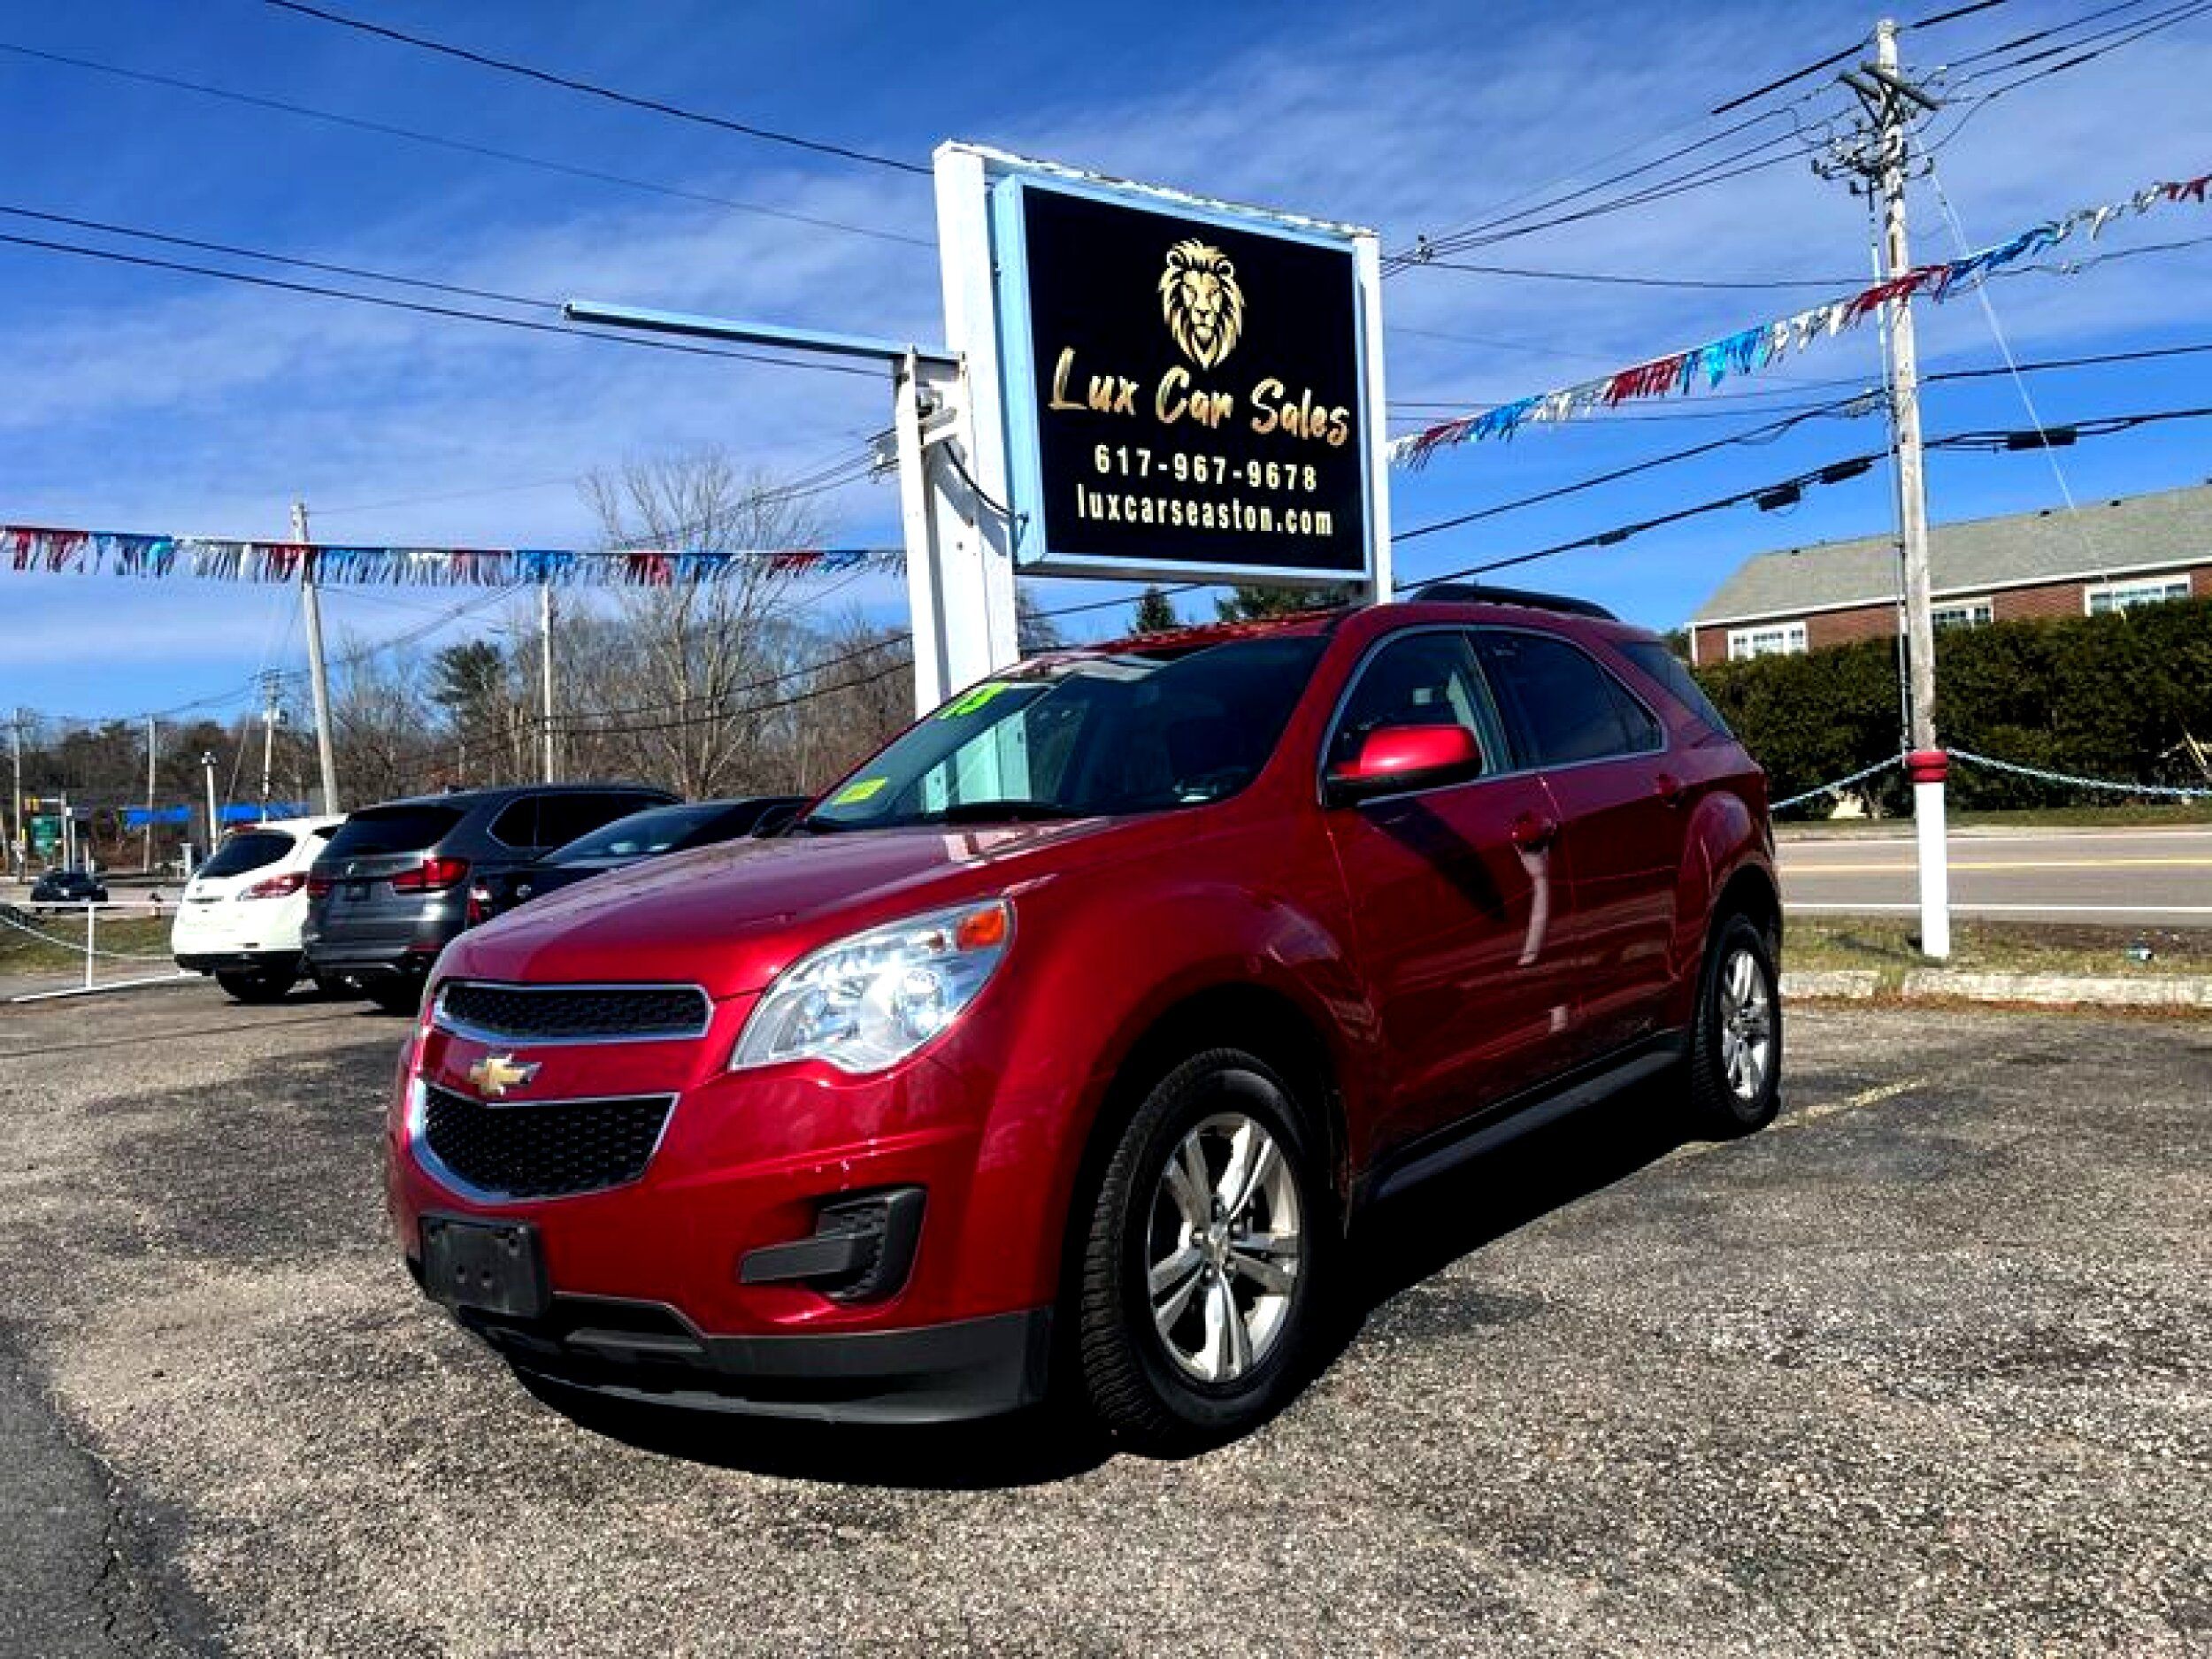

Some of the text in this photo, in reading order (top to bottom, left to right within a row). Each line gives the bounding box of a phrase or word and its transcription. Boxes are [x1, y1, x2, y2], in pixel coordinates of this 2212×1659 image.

[1048, 346, 1350, 446] Lux Car Sales
[1094, 444, 1317, 492] 617-967-9678
[1077, 483, 1333, 536] luxcarseaston.com
